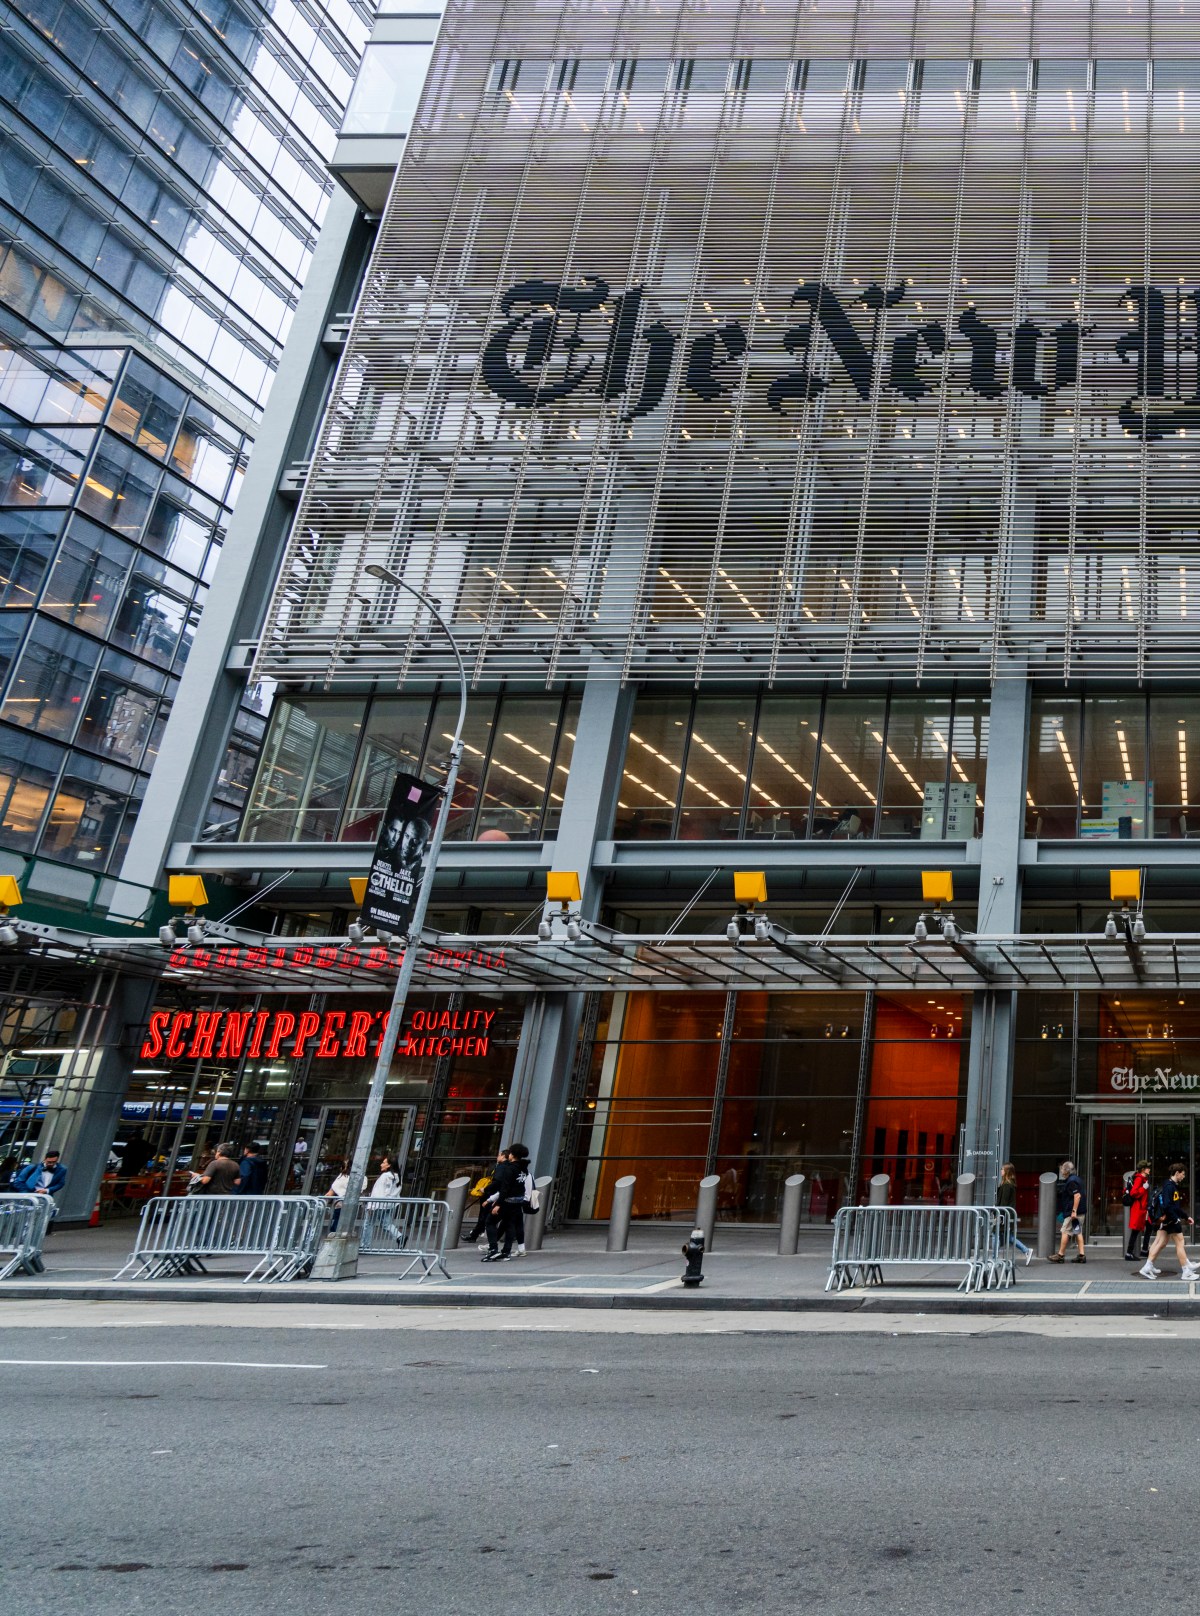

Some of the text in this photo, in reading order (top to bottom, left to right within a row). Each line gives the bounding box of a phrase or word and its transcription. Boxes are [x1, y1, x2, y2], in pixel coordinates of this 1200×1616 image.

[481, 276, 745, 423] The
[767, 281, 1096, 415] New
[370, 872, 414, 897] OTHELLO
[412, 1010, 495, 1030] QUALITY
[406, 1036, 489, 1057] KITCHEN
[1111, 1066, 1151, 1093] The
[1153, 1067, 1200, 1092] New
